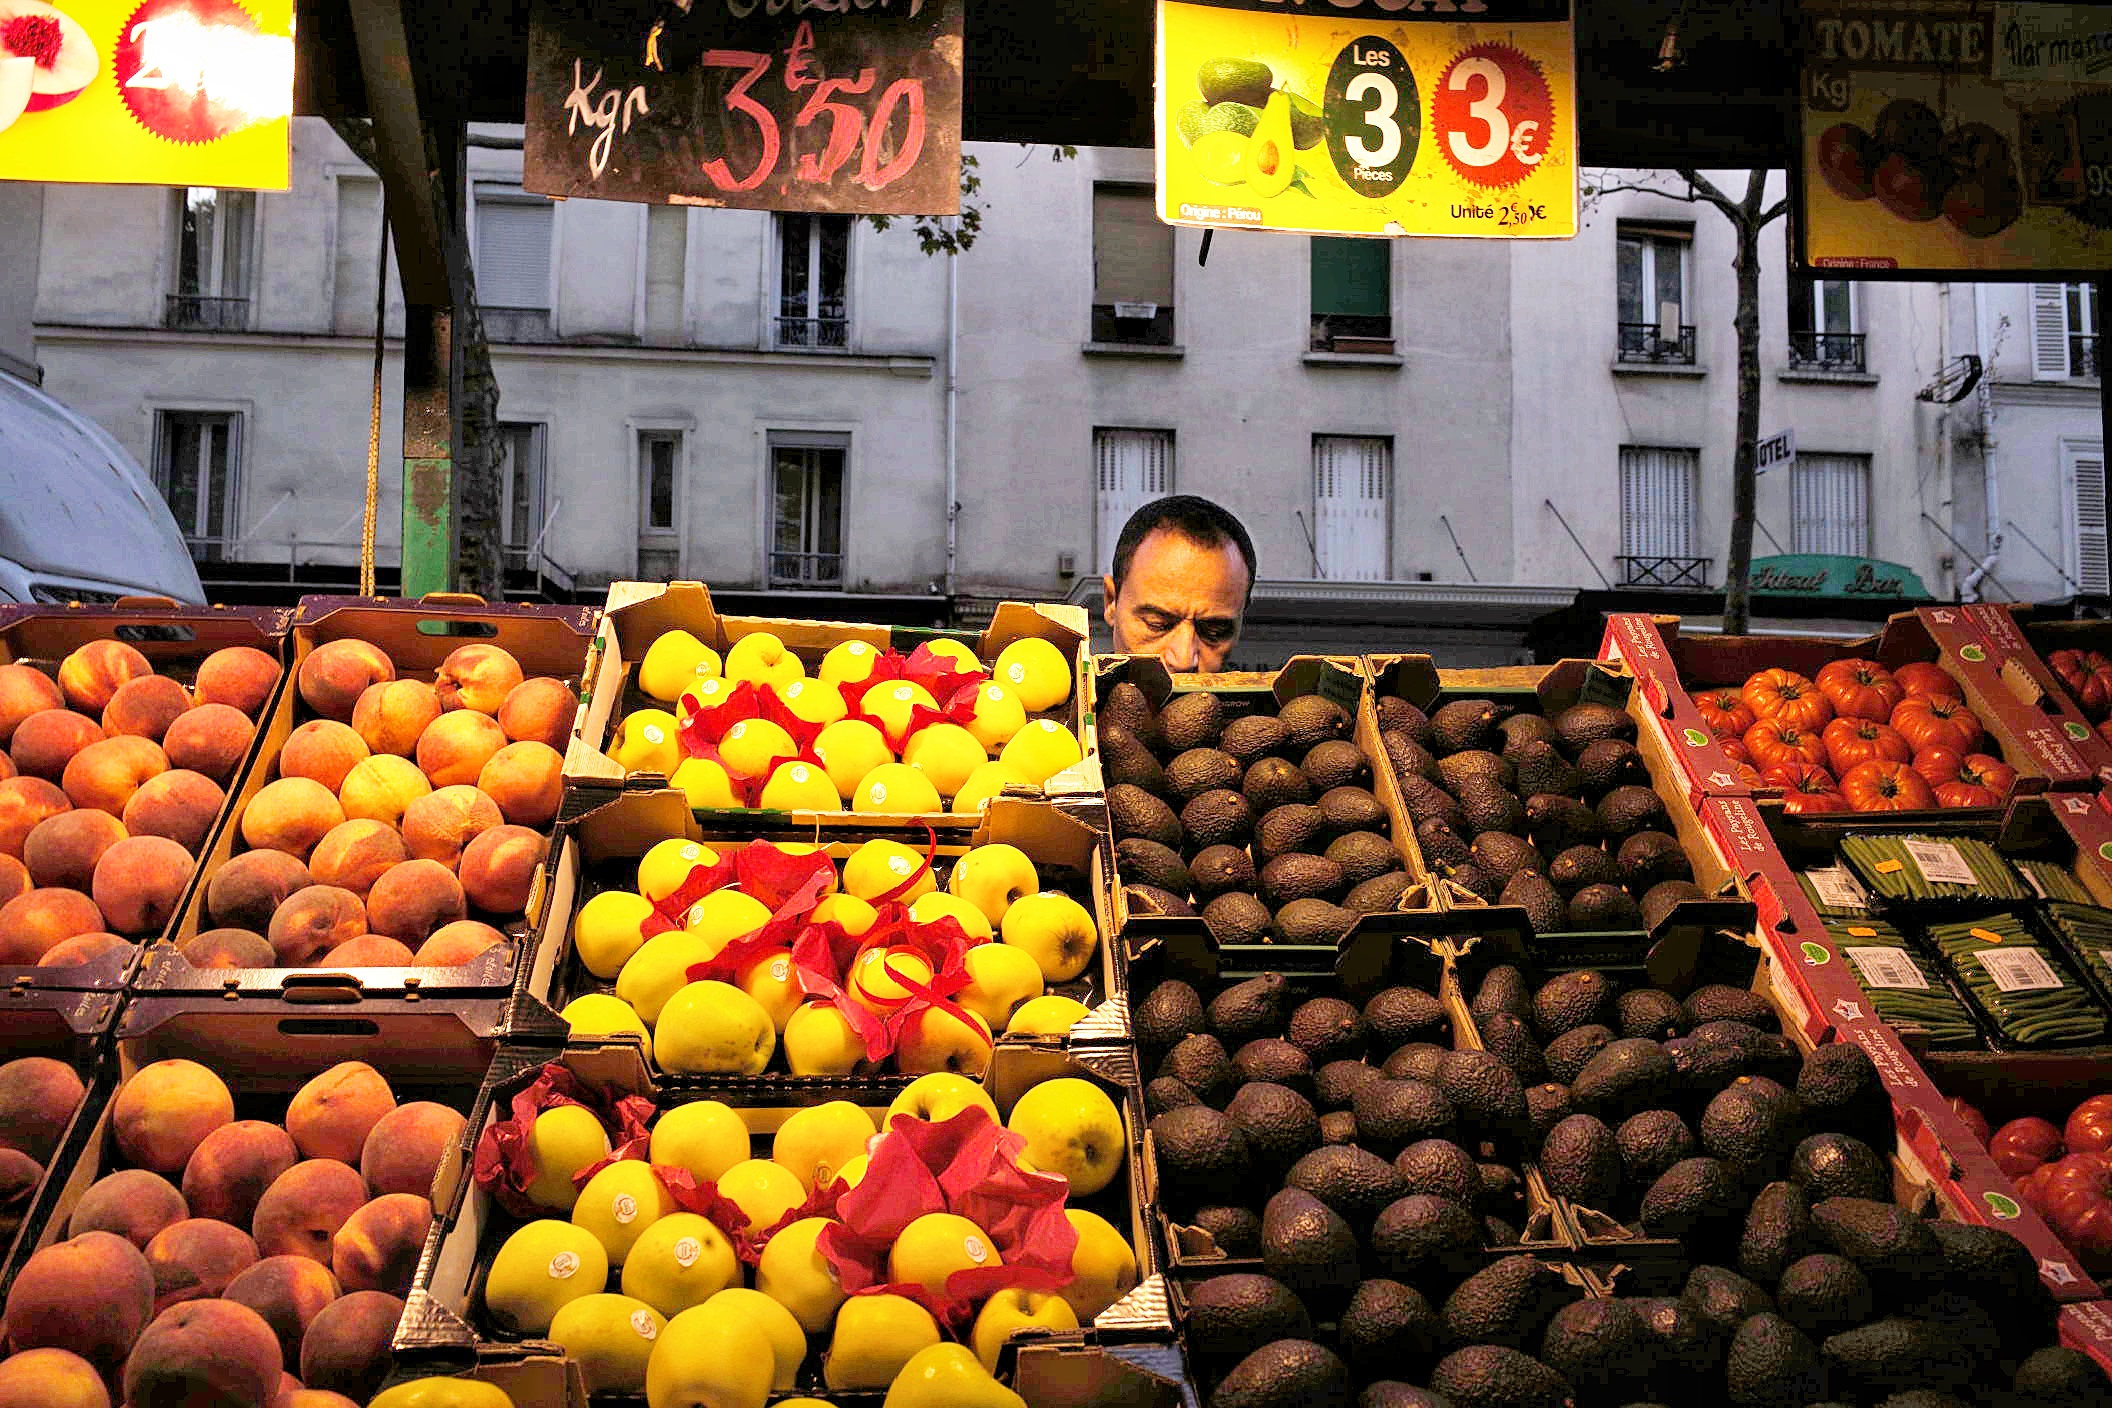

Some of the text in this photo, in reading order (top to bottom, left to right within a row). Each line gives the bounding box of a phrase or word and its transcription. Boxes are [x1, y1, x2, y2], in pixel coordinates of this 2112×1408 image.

[1353, 45, 1391, 66] Les
[1816, 19, 1985, 64] TOMATE
[1811, 71, 1849, 108] Kg
[1344, 72, 1402, 168] 3
[1181, 205, 1220, 221] Origine
[1228, 208, 1260, 222] Pérou
[1451, 204, 1494, 218] Unité
[1718, 800, 1752, 851] Les Paysans
[1732, 800, 1759, 840] Rougeline
